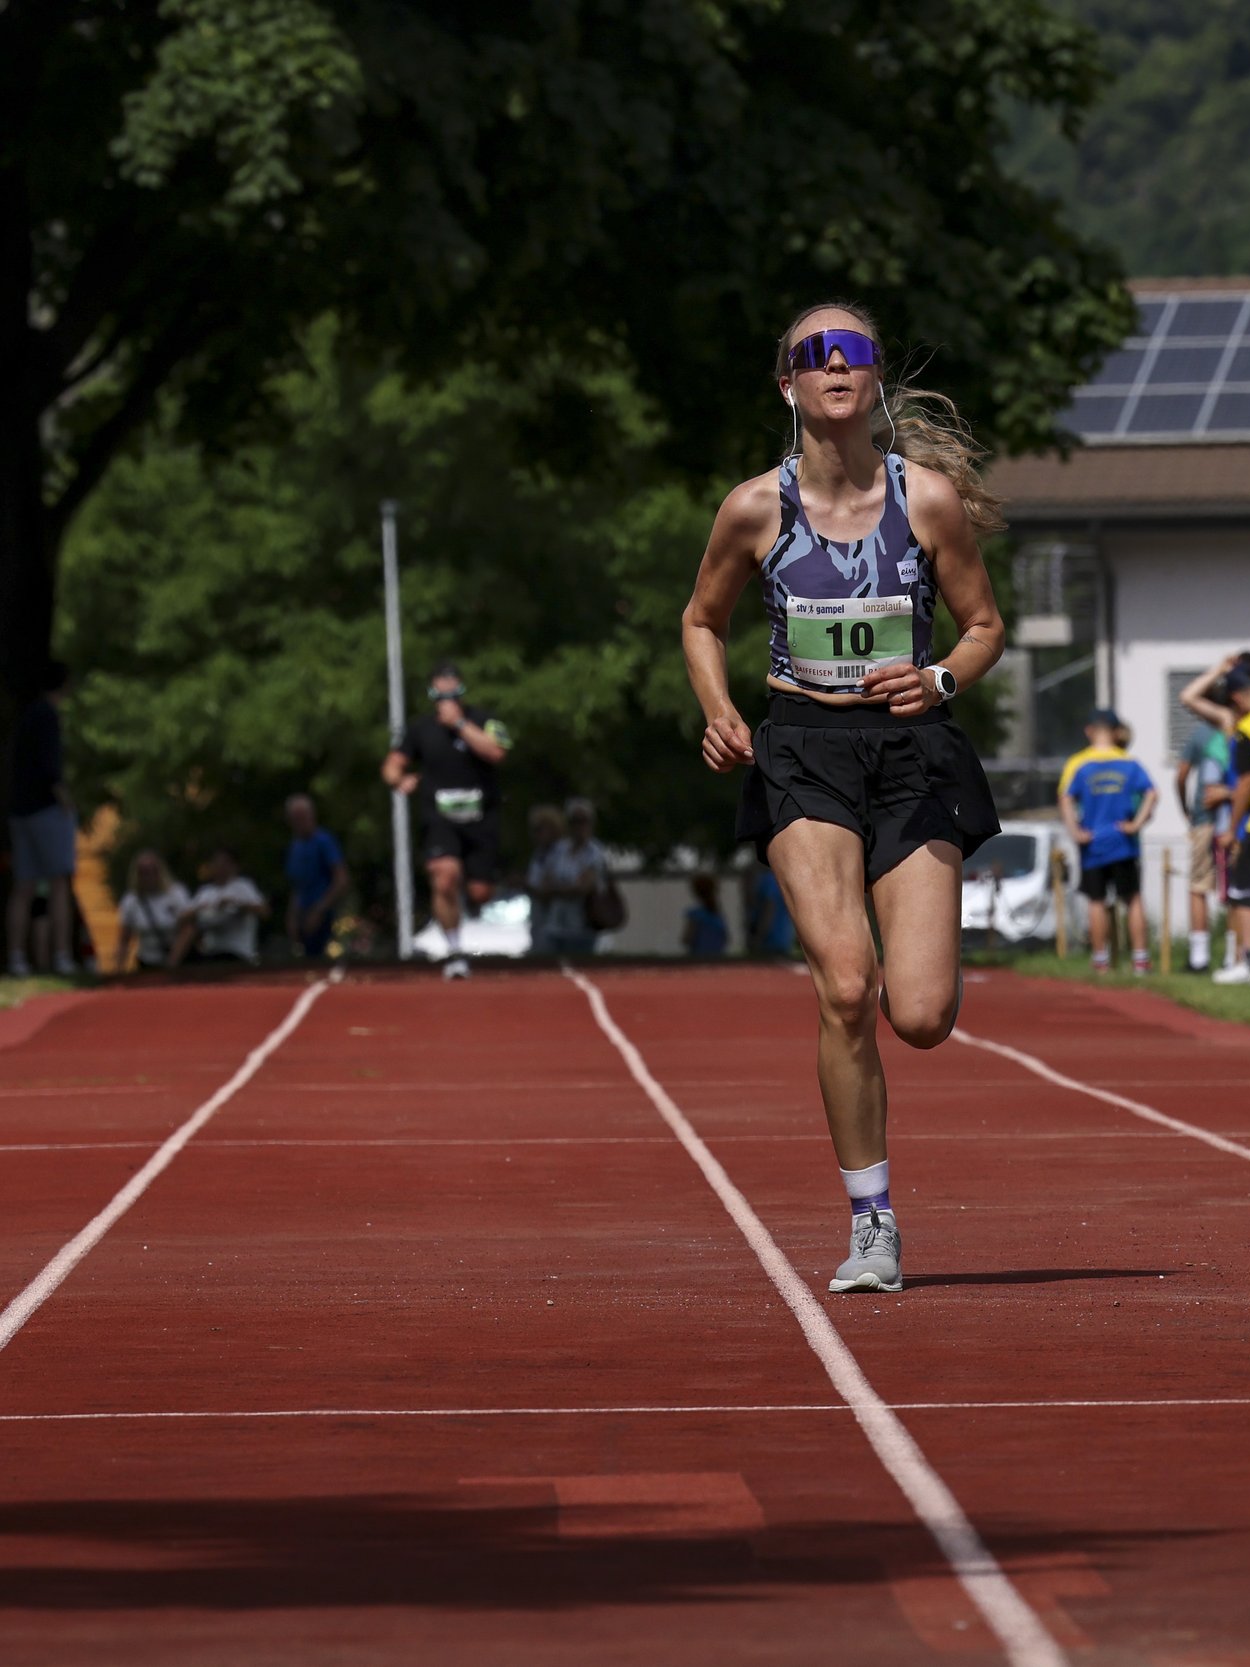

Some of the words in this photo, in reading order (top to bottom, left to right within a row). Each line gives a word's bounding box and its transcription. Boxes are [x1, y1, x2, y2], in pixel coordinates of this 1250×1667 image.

[796, 604, 807, 613] stv
[816, 604, 845, 615] gampel
[862, 600, 902, 613] lonzalauf
[826, 622, 874, 656] 10
[794, 665, 833, 677] RAIFFEISEN
